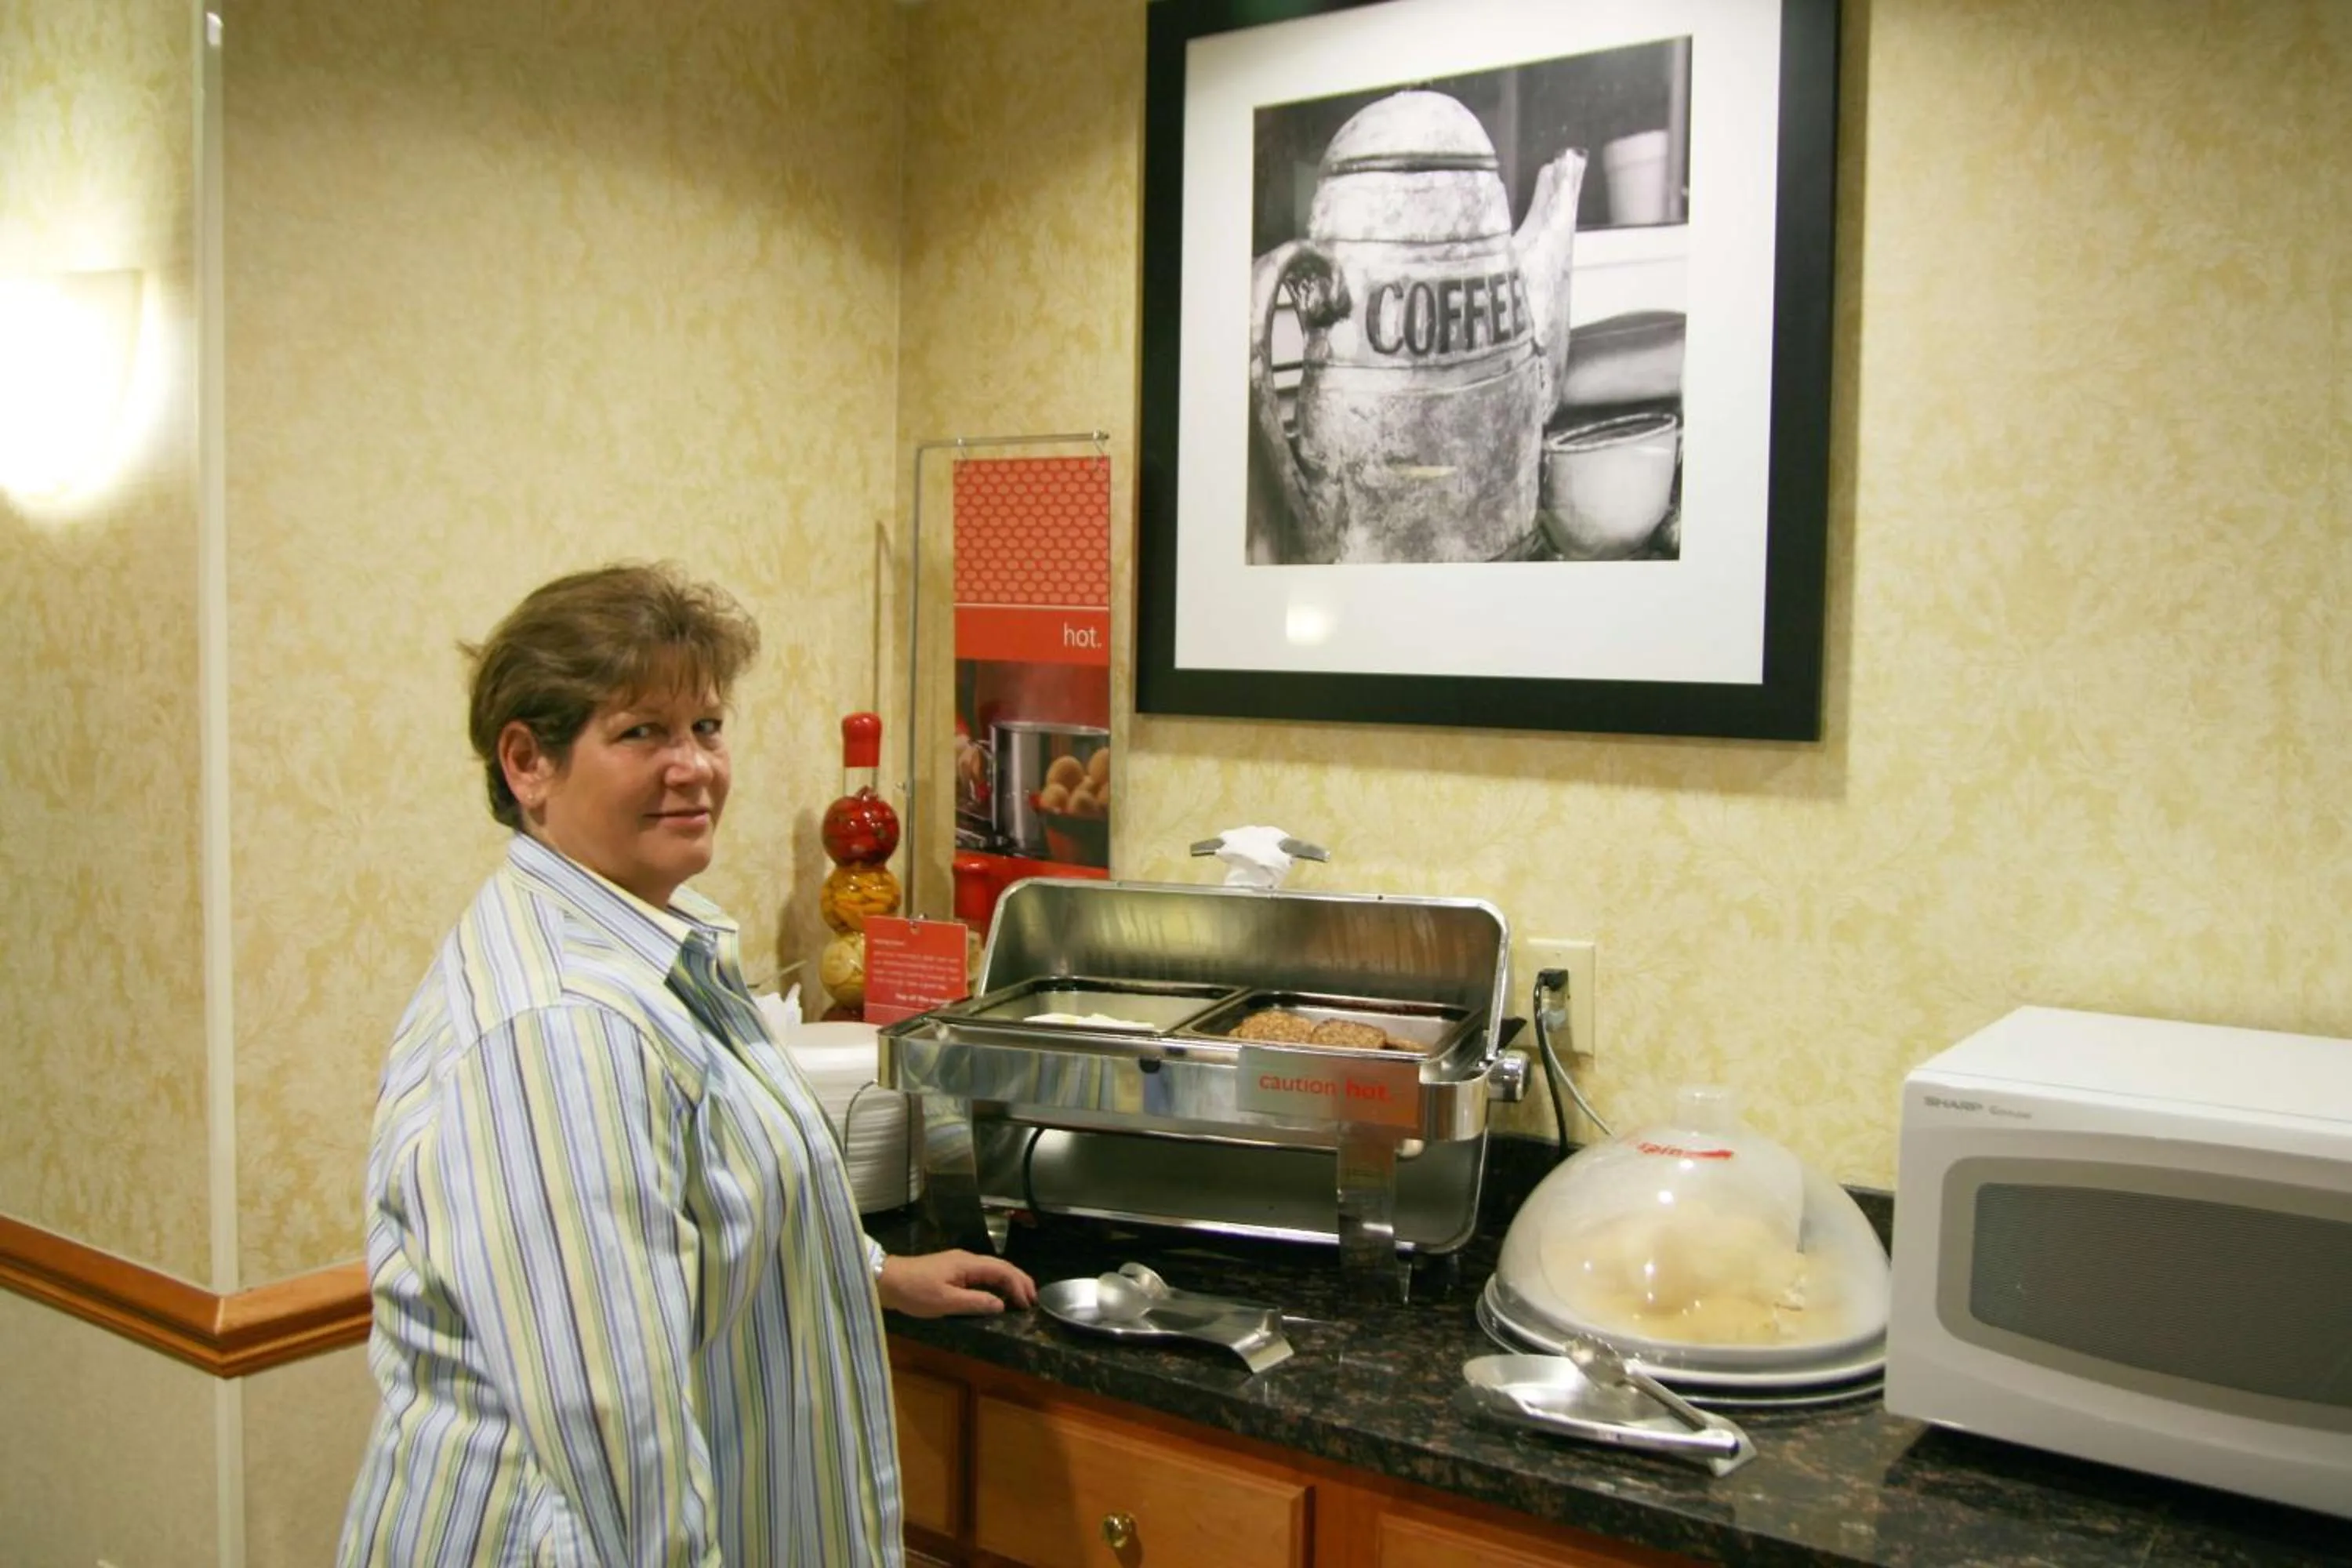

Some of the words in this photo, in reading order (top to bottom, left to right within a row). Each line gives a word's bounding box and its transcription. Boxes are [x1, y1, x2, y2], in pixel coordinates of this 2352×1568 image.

[1366, 269, 1527, 356] COFFEE
[1063, 622, 1102, 649] hot.
[1259, 1075, 1338, 1097] caution
[1923, 1095, 1984, 1112] SHARP
